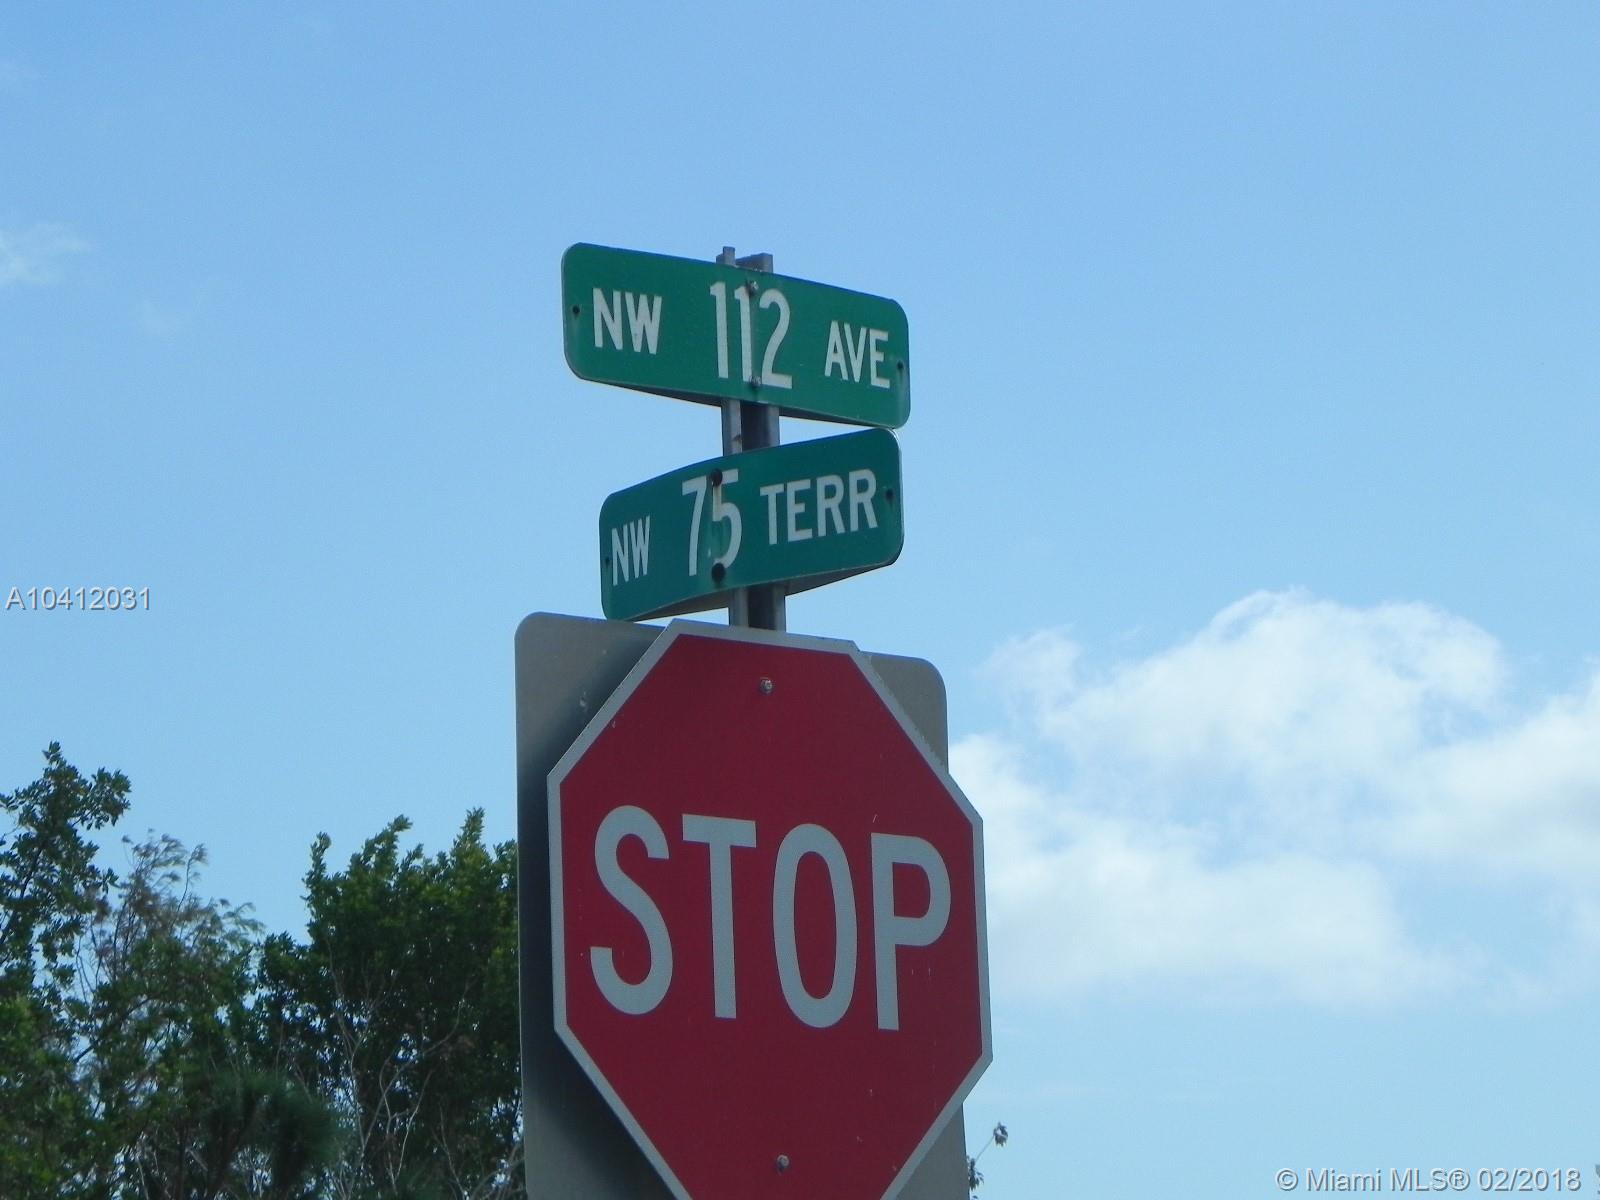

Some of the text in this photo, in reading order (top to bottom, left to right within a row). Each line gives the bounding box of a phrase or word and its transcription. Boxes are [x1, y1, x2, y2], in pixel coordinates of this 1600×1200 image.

[593, 281, 890, 390] NW 112 AVE
[611, 468, 878, 586] NW 75 TERR
[590, 805, 951, 1031] STOP
